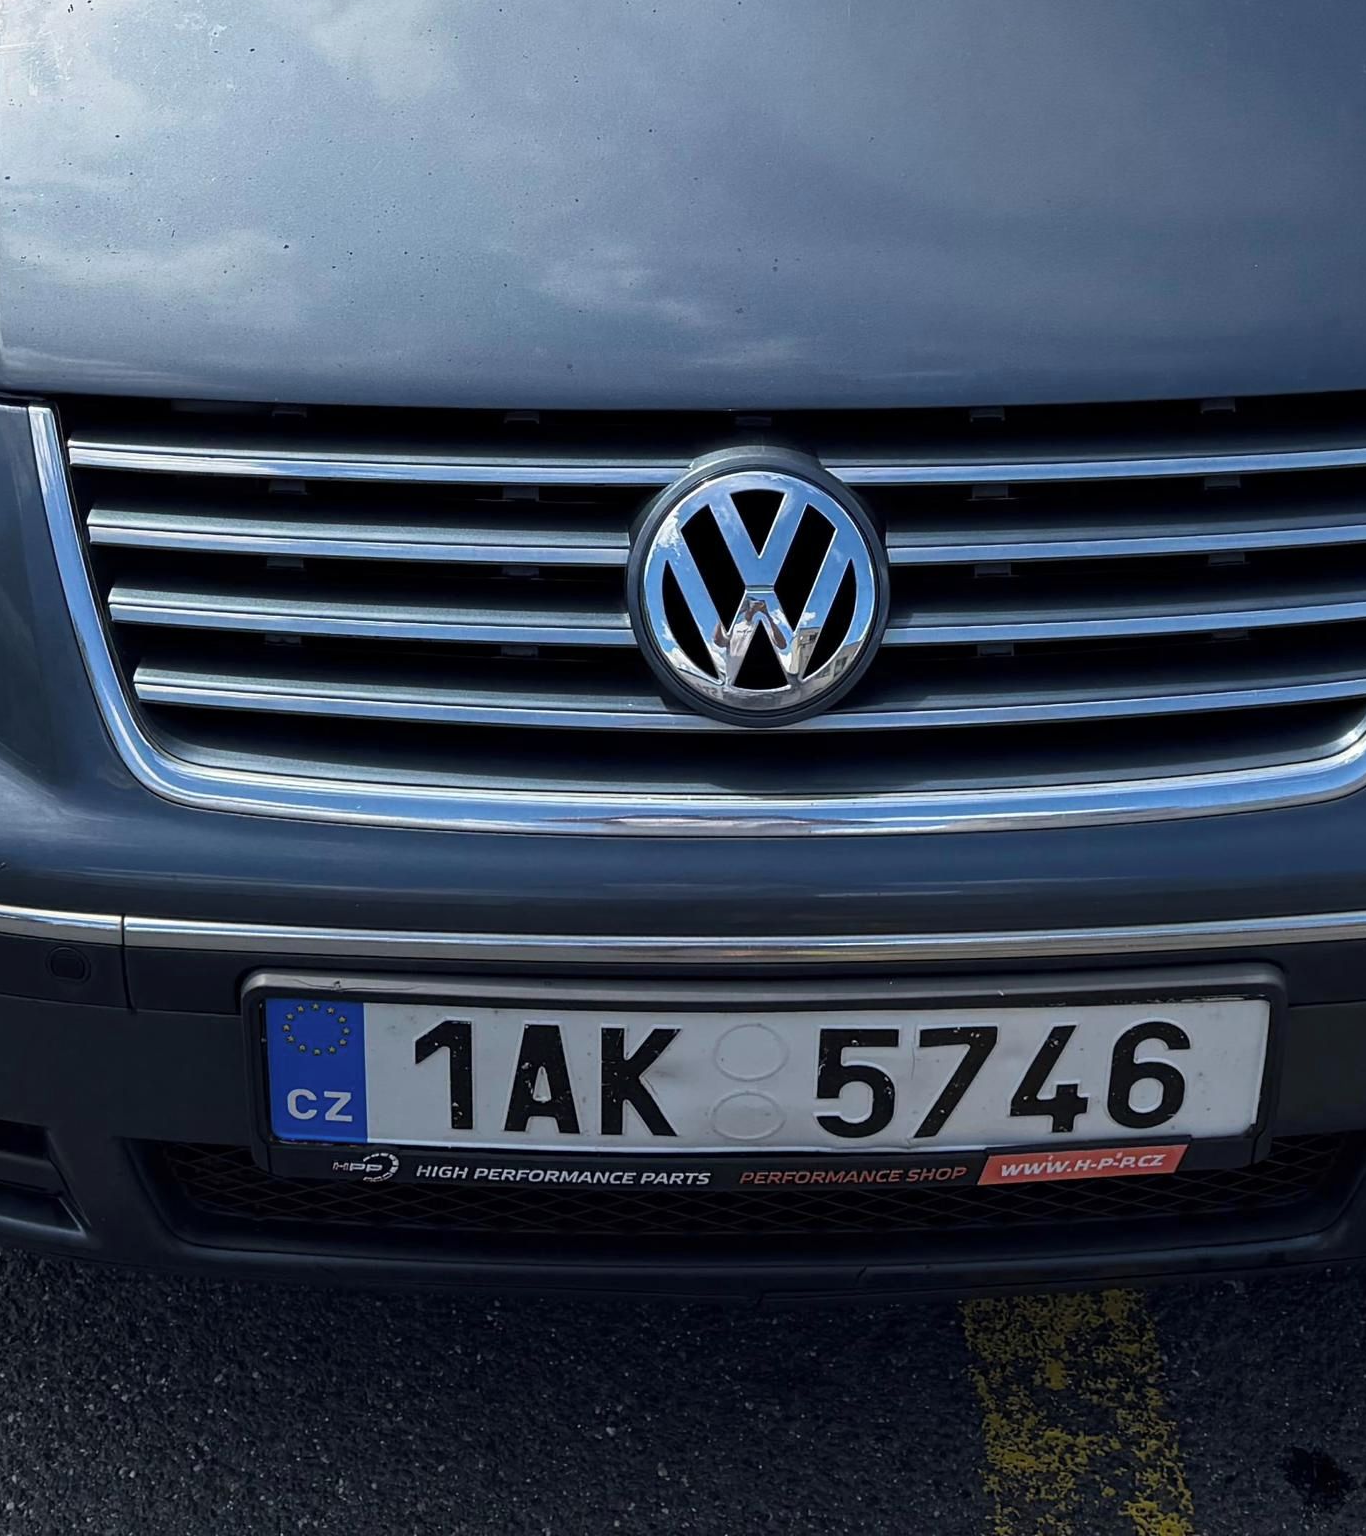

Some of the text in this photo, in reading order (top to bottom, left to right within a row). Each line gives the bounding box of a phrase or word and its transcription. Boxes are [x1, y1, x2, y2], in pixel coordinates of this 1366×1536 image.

[415, 1019, 1191, 1139] 1AK 5746
[287, 1088, 353, 1123] CZ
[416, 1165, 712, 1185] HIGH PERFORMANCE PARTS
[739, 1166, 968, 1185] PERFORMANCE SHOP
